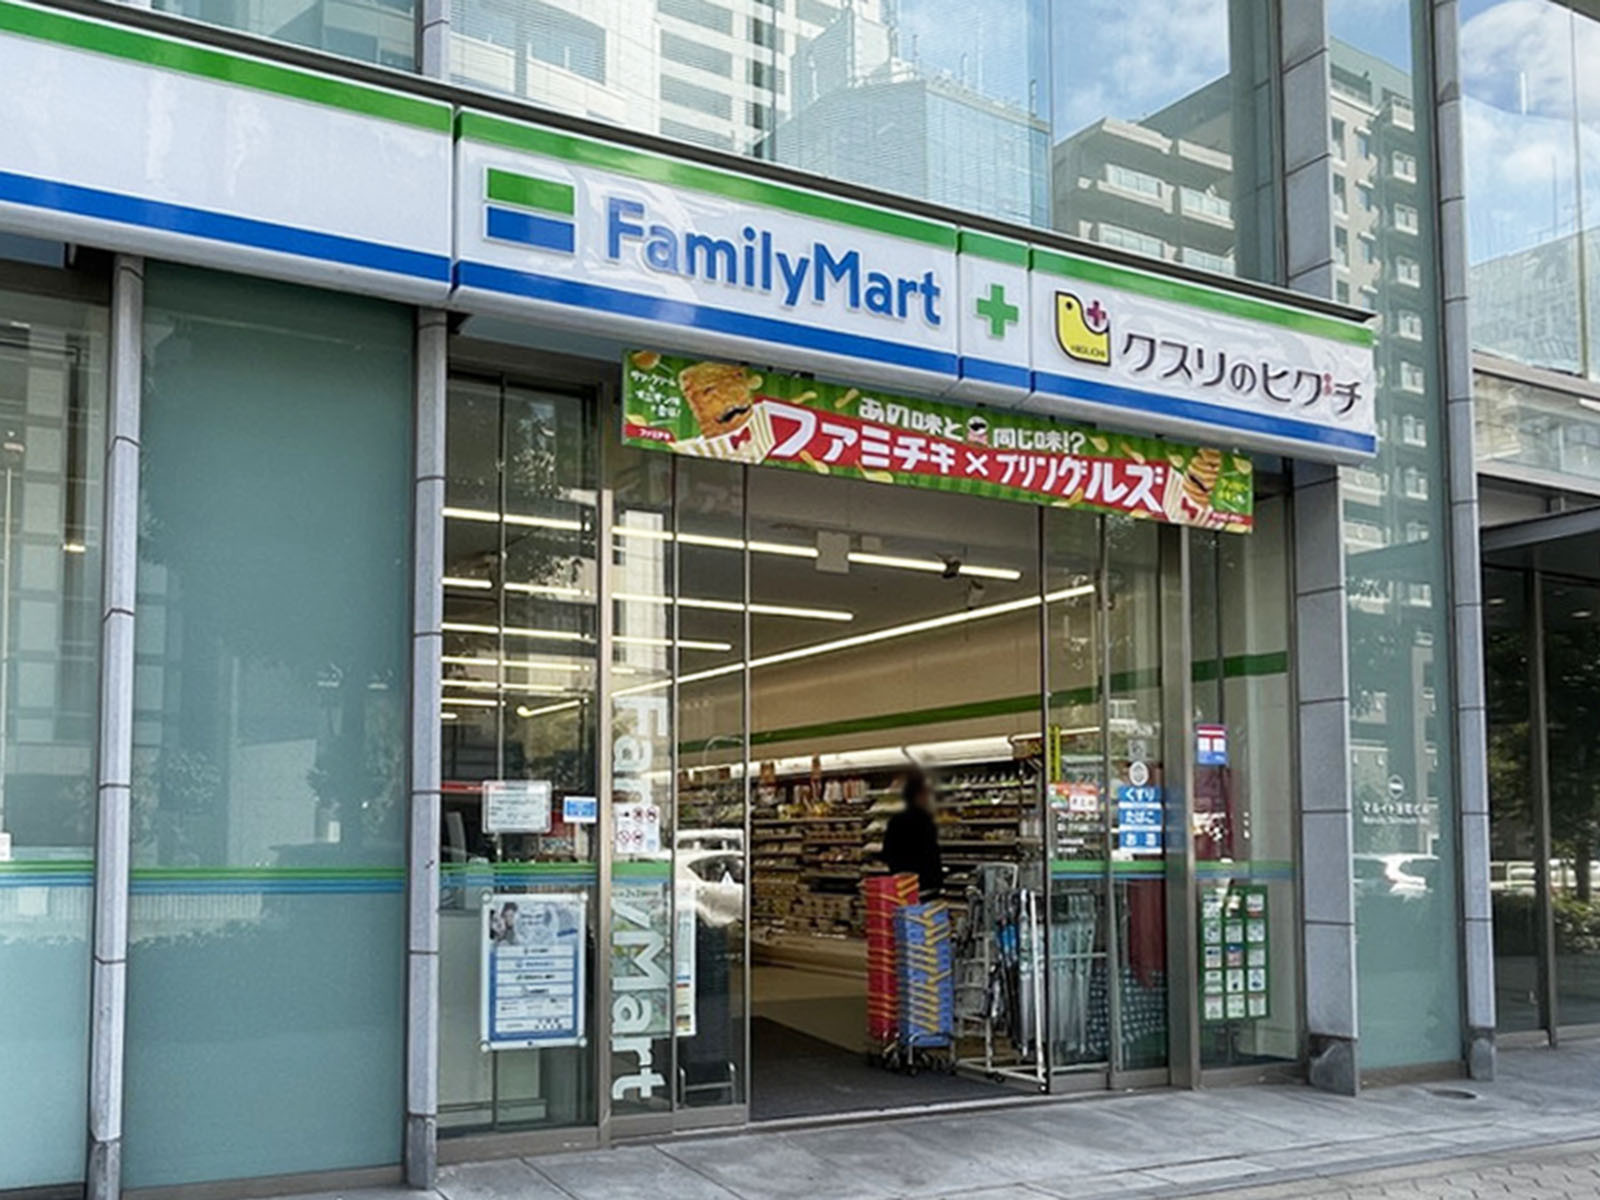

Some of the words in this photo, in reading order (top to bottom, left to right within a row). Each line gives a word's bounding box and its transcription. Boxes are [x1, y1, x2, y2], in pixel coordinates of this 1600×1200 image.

[606, 196, 942, 326] FamilyMart
[1122, 332, 1362, 415] クスリのヒグチ
[762, 400, 956, 474] ファミチキ
[858, 397, 964, 441] あの味と
